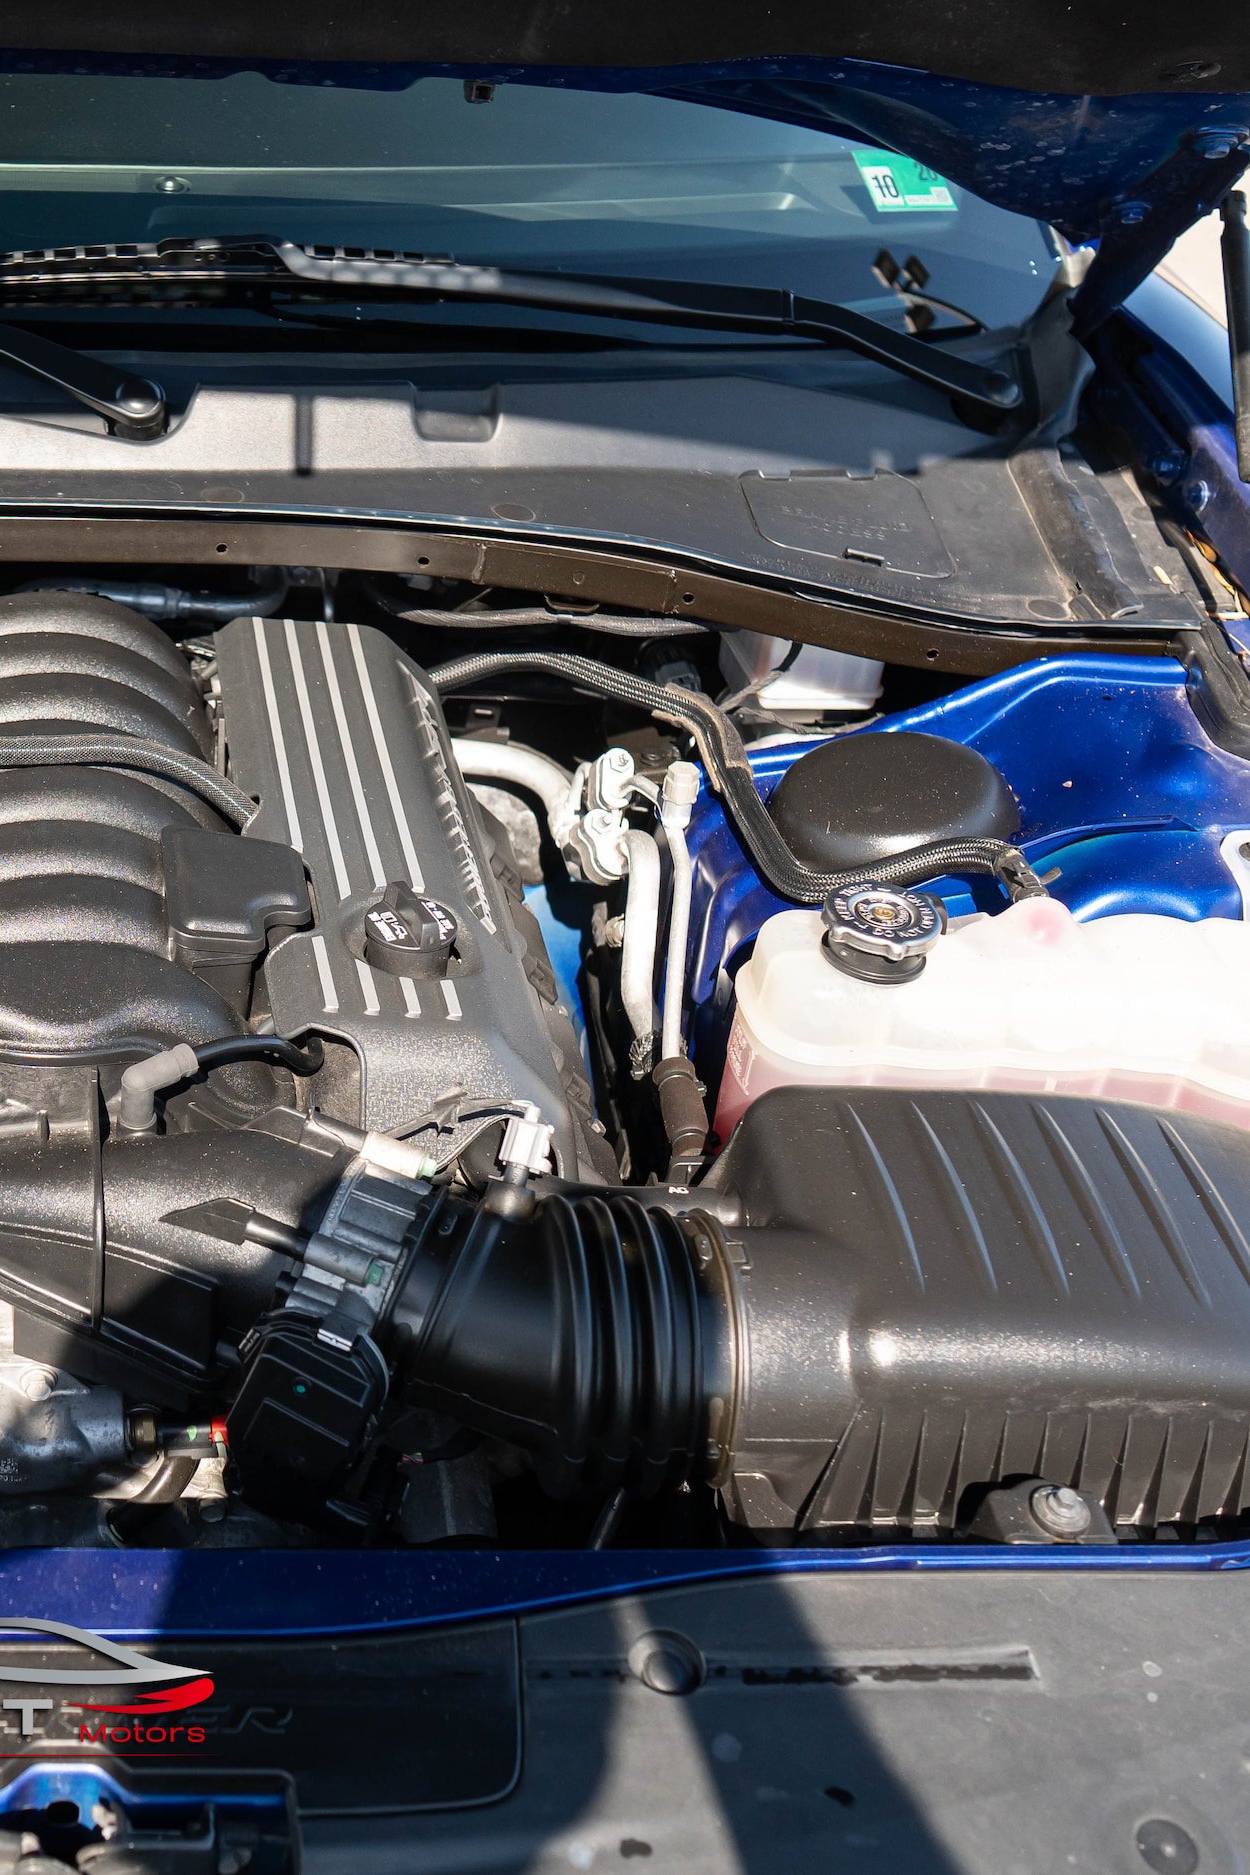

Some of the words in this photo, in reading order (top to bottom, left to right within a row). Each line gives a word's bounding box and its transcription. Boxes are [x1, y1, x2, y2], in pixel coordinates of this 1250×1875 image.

[872, 175, 899, 198] 10
[839, 884, 872, 897] TIGHT
[898, 892, 925, 908] HOT
[834, 898, 855, 920] KEEP
[919, 907, 934, 928] OPEN
[873, 928, 895, 937] DO
[898, 927, 923, 937] NOT
